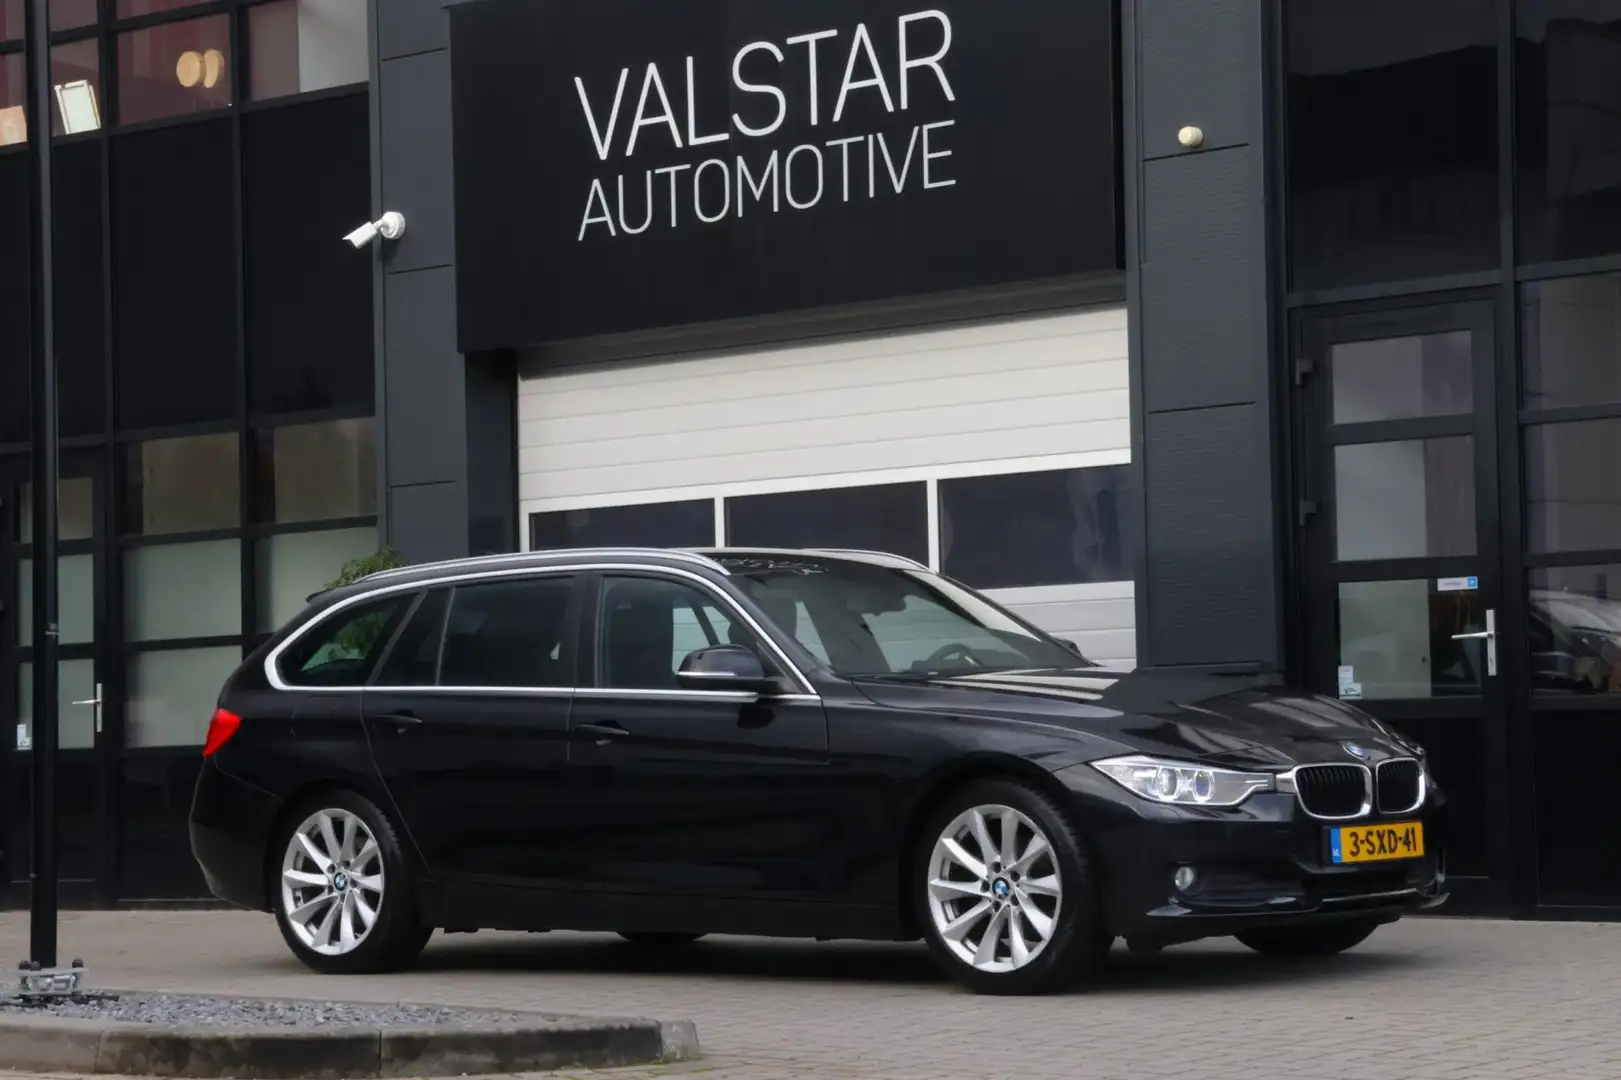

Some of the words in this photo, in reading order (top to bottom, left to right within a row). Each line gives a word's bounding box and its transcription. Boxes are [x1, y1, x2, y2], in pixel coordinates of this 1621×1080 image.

[574, 9, 956, 161] VALSTAR
[577, 119, 957, 242] AUTOMOTIVE
[1349, 827, 1417, 857] 3-SXD-41
